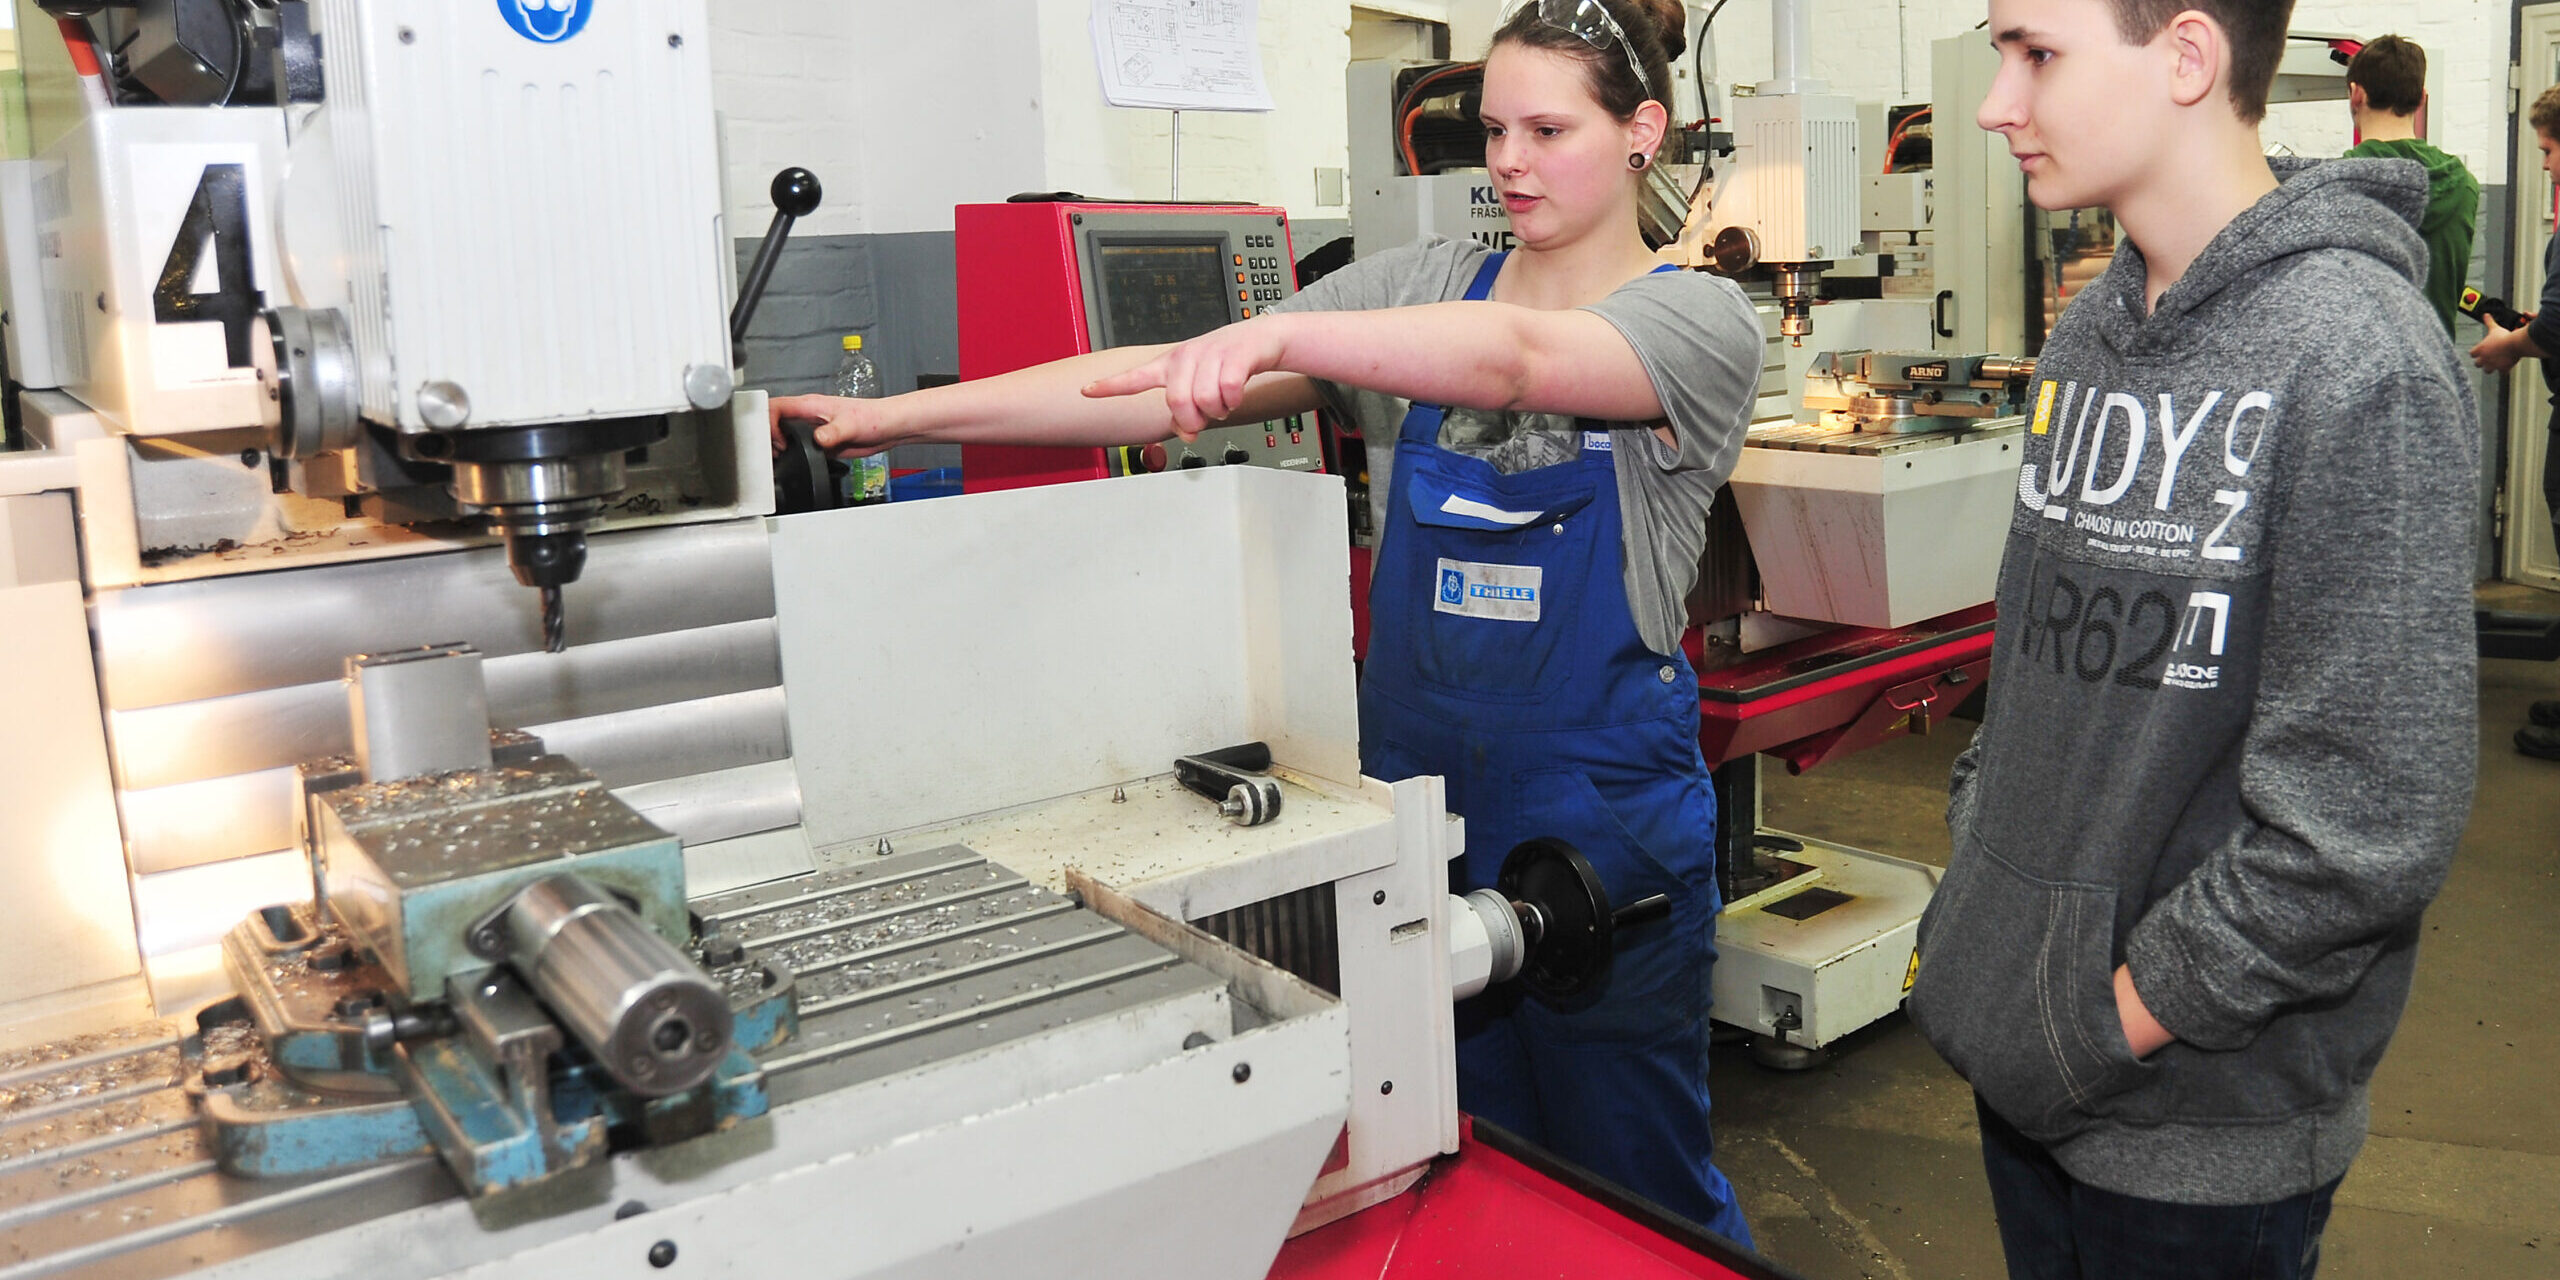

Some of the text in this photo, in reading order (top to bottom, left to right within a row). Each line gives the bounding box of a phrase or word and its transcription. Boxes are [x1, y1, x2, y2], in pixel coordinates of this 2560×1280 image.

[1471, 186, 1500, 204] KU
[153, 162, 265, 368] 4
[1909, 366, 1943, 377] ARNO
[1588, 434, 1611, 449] boco
[2074, 511, 2194, 543] CHAOS IN COTTON
[1471, 585, 1532, 600] THIELE
